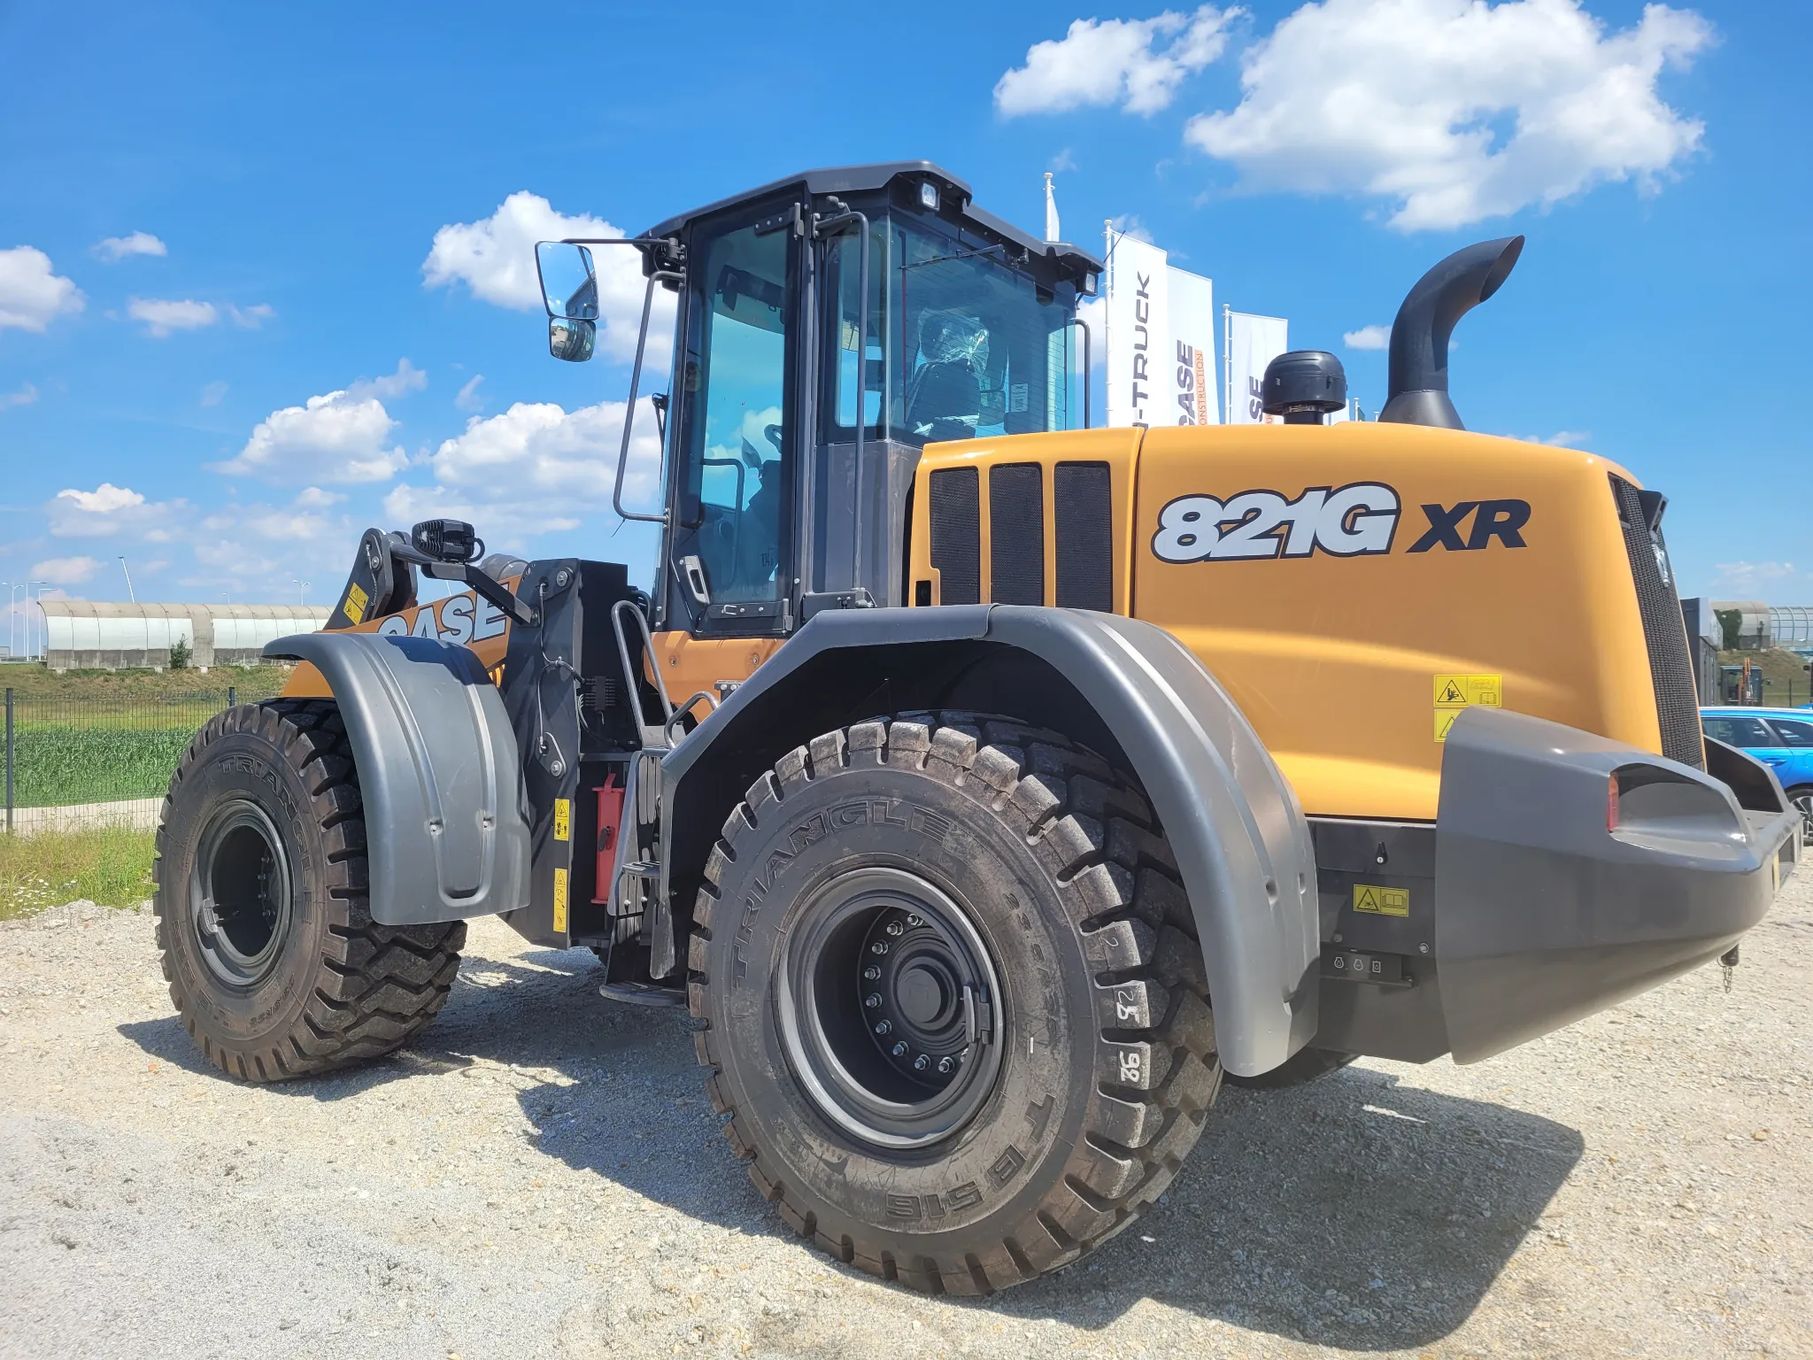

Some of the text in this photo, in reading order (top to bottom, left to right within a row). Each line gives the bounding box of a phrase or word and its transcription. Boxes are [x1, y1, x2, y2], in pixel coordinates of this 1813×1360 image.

[1195, 352, 1207, 426] ONSTRUCTION
[1249, 375, 1264, 423] SE
[1151, 481, 1532, 564] 821G XR
[732, 800, 951, 985] TRIANGLE
